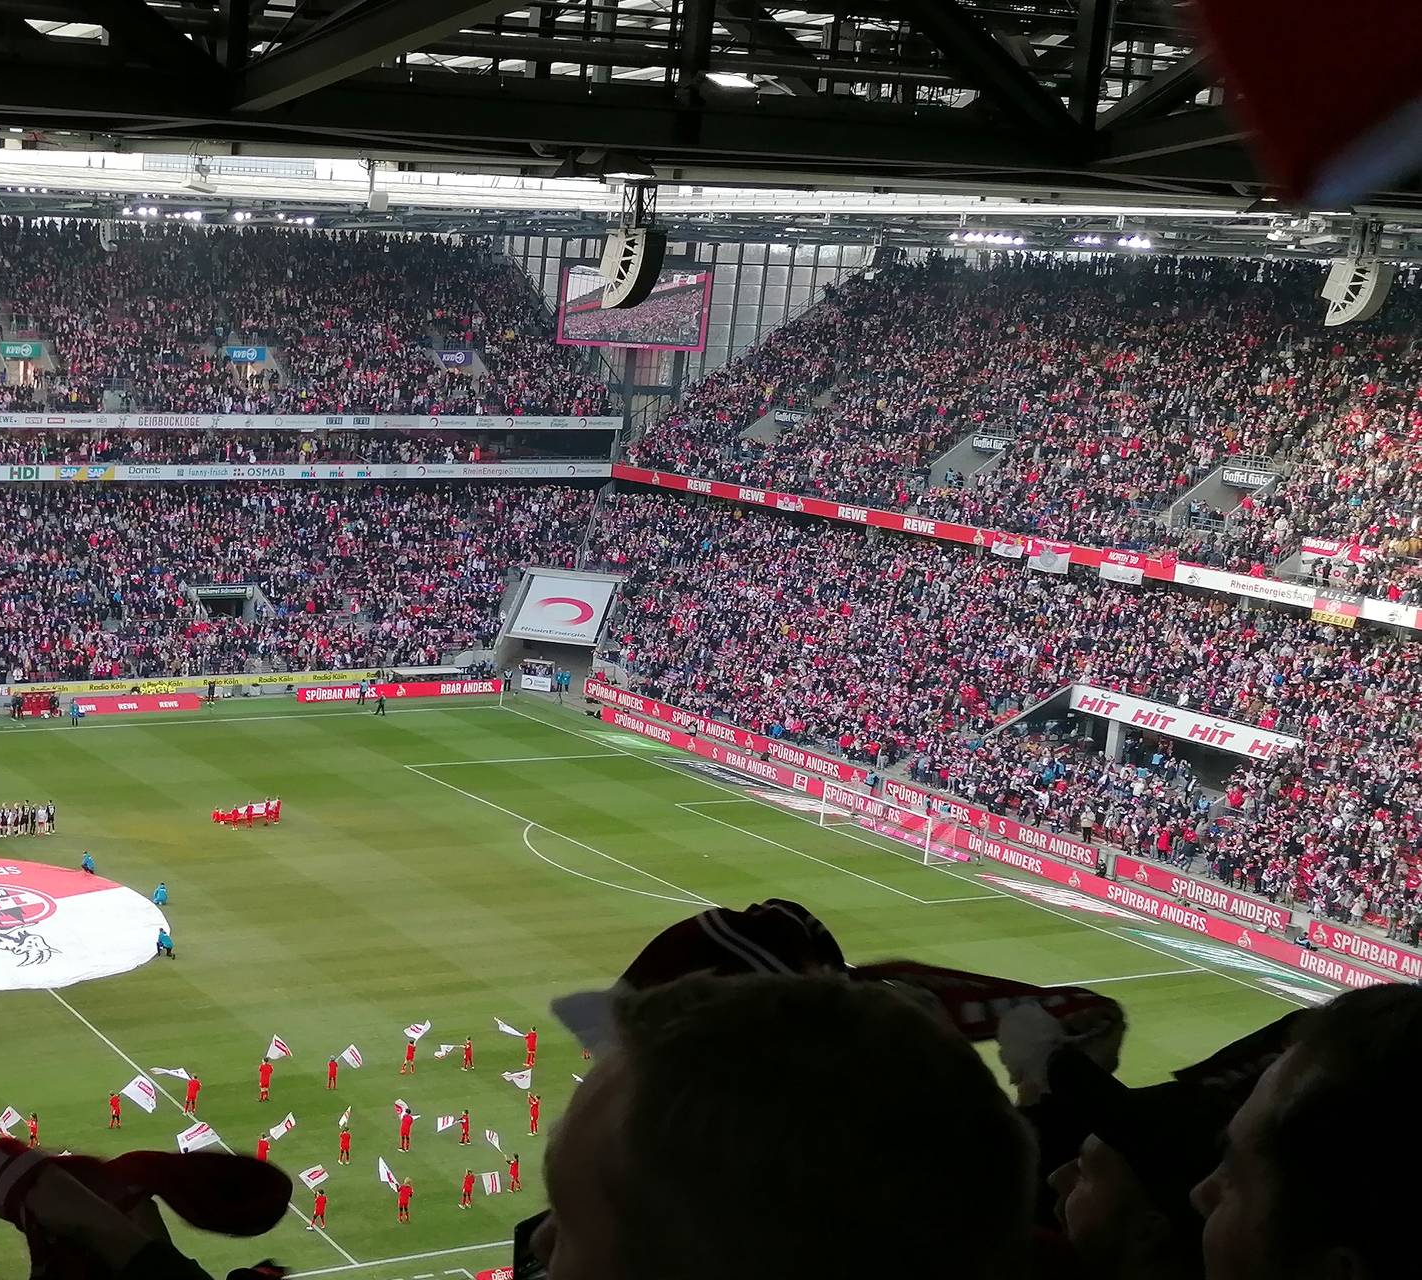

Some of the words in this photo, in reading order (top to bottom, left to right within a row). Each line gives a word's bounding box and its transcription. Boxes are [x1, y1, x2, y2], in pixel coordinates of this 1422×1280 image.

[9, 467, 40, 480] HDI
[60, 467, 77, 478] SAP
[87, 467, 105, 478] SAP
[128, 466, 161, 474] Dorint
[247, 468, 286, 477] OSMAB
[1223, 470, 1247, 483] Gaffel
[686, 478, 712, 493] REWE
[738, 488, 766, 503] REWE
[837, 506, 868, 522] REWE
[903, 518, 937, 535] REWE
[1320, 591, 1358, 604] ALLEZ
[89, 684, 109, 692] Radio
[110, 682, 127, 691] Köln
[223, 677, 239, 686] Köln
[463, 680, 495, 693] ANDERS.
[305, 687, 343, 702] SPÜRBAR
[344, 686, 378, 700] ANDRS.
[587, 681, 617, 703] SPÜRBAR
[118, 702, 138, 711] REWE
[158, 700, 179, 709] REWE
[614, 711, 644, 735] SPÜRBAR
[1077, 695, 1120, 715] HIT
[1131, 709, 1177, 731] HIT
[1188, 723, 1236, 746] HIT
[706, 722, 737, 744] ANDERS.
[767, 741, 805, 767] SPÜRBAR
[806, 753, 841, 778] ANDERS.
[746, 758, 778, 781] ANDERS.
[1049, 836, 1094, 866] ANDERS.
[1002, 848, 1044, 875] ANDERS.
[1107, 884, 1158, 915] SPÜRBAR
[1161, 904, 1209, 934] ANDERS.
[1171, 877, 1228, 910] SPÜRBAR
[1230, 898, 1284, 931] ANDERS.
[1332, 931, 1398, 968] SPÜRBAR
[1299, 949, 1344, 981] ÜRBAR
